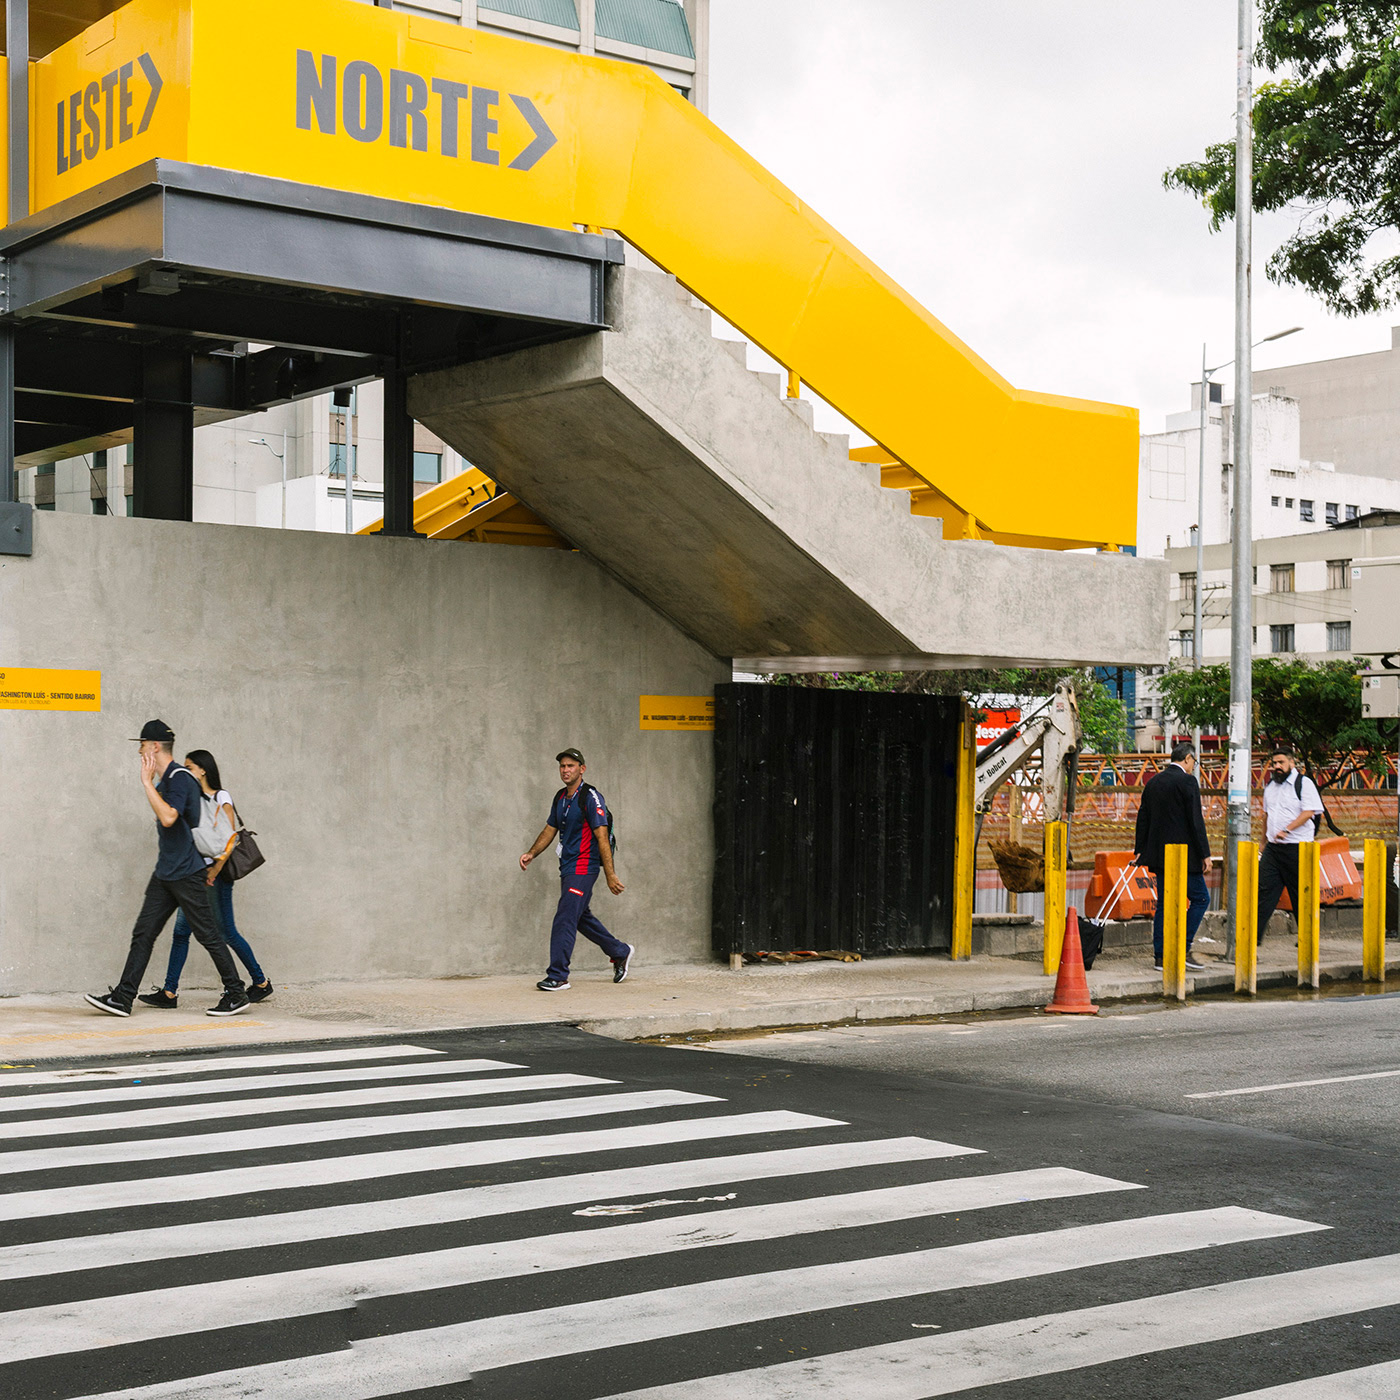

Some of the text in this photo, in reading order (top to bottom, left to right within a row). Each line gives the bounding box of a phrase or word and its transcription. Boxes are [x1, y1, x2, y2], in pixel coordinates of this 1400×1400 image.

[57, 60, 133, 176] LESTE
[296, 48, 499, 166] NORTE
[33, 690, 45, 699] LUÍS
[986, 757, 1007, 777] Bobcat
